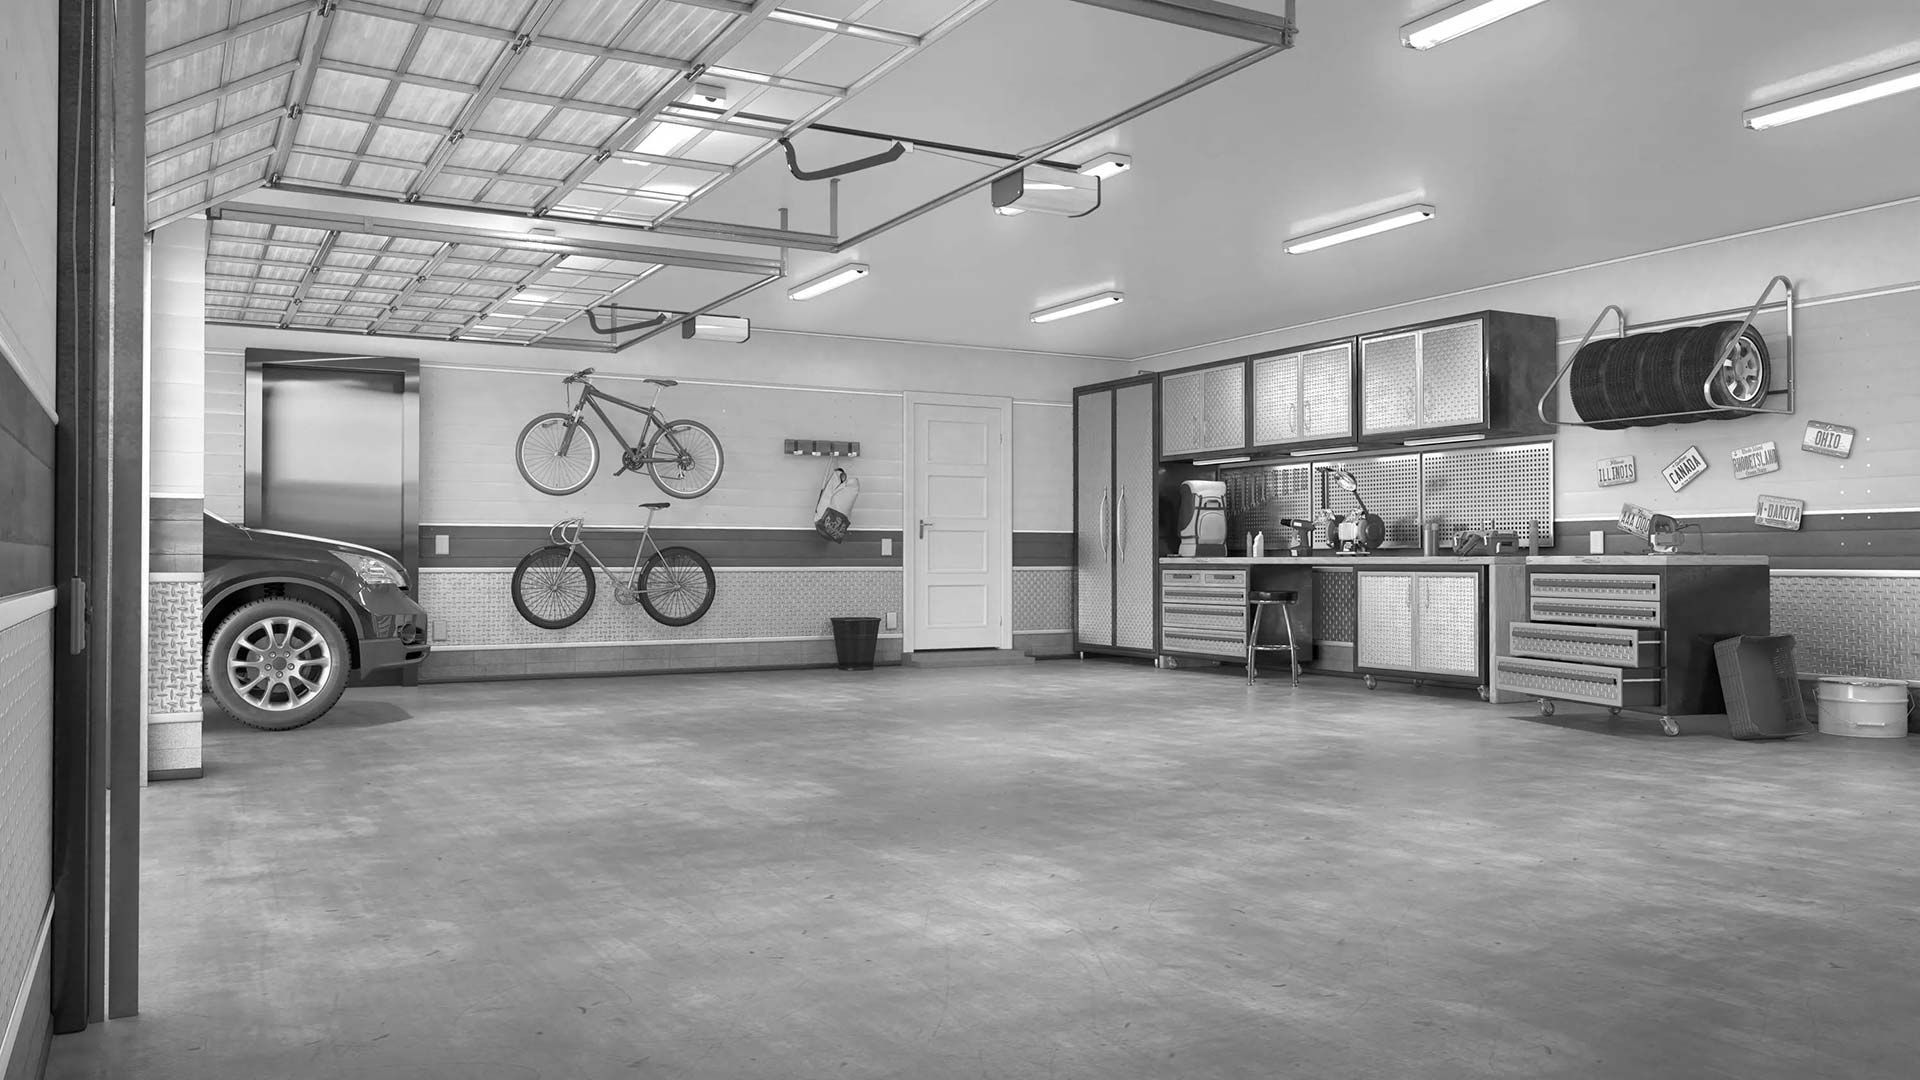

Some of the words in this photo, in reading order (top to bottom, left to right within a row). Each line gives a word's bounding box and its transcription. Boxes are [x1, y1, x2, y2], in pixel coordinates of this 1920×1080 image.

[1815, 430, 1841, 449] OHIO
[1598, 463, 1633, 482] ILLINOIS
[1669, 454, 1701, 485] CANADA
